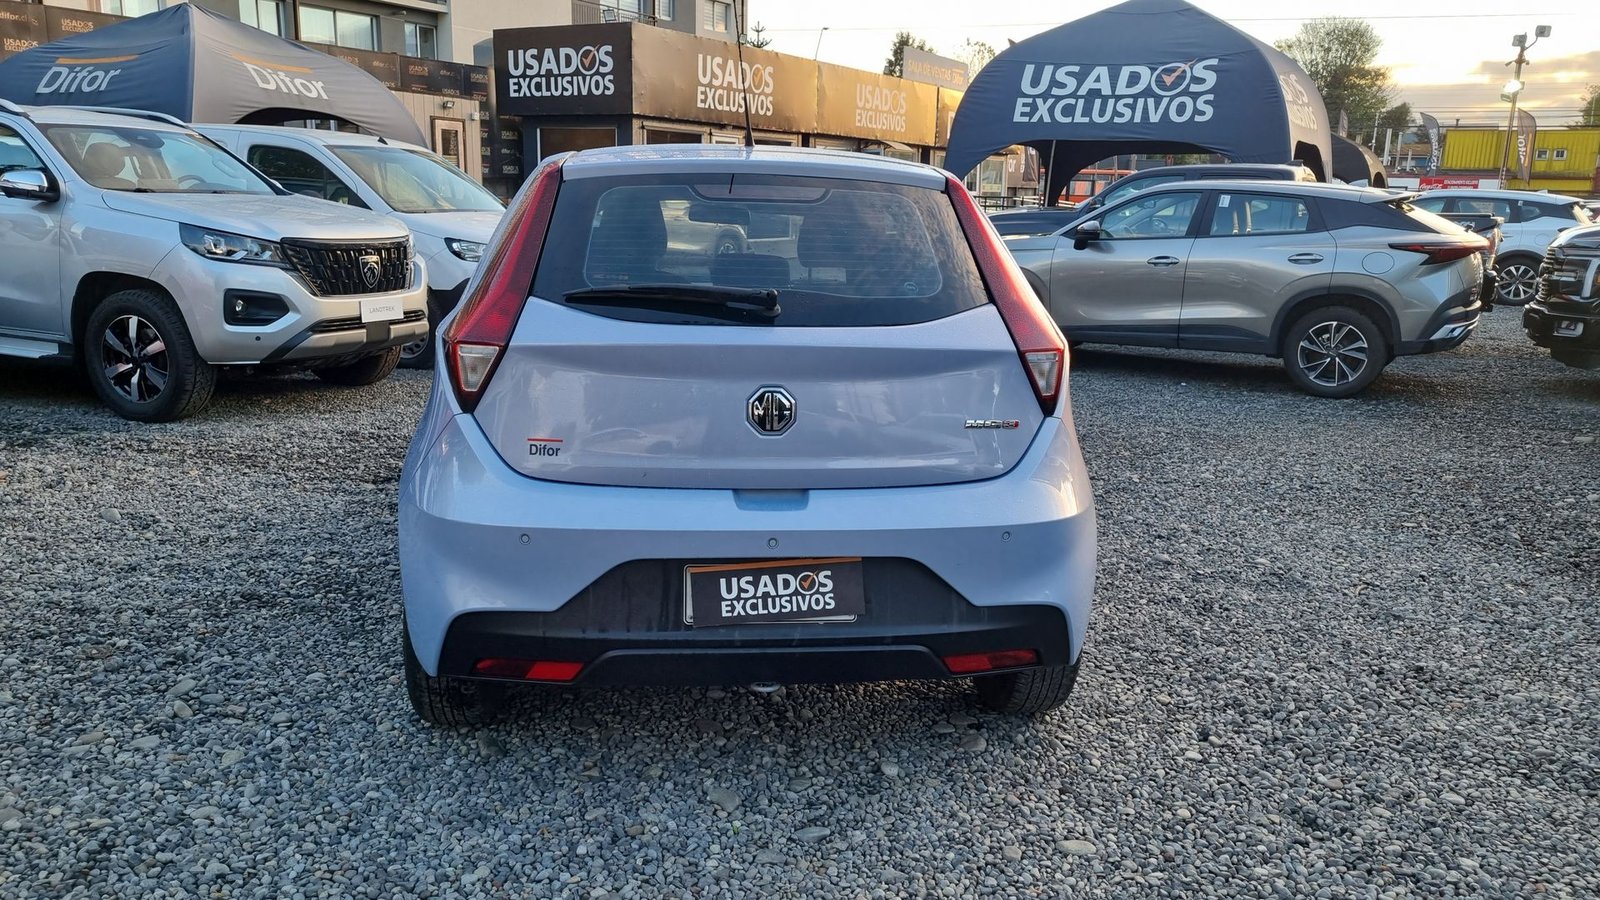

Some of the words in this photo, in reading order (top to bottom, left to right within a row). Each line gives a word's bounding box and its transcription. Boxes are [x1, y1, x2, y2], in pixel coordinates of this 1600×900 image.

[61, 18, 94, 29] USADOS
[4, 38, 39, 48] USADOS
[507, 45, 614, 77] USADOS
[697, 53, 774, 94] USADOS
[35, 66, 121, 94] Difor
[242, 60, 329, 100] Difor
[509, 75, 615, 98] EXCLUSIVOS
[1019, 58, 1219, 96] USADOS
[696, 85, 774, 117] EXCLUSIVOS
[856, 83, 907, 114] USADOS
[1013, 95, 1214, 123] EXCLUSIVOS
[855, 109, 906, 132] EXCLUSIVOS
[753, 392, 791, 431] MG
[964, 419, 1020, 430] MG3
[529, 444, 561, 457] Difor
[719, 570, 834, 600] USADOS
[721, 593, 836, 617] EXCLUSIVOS
